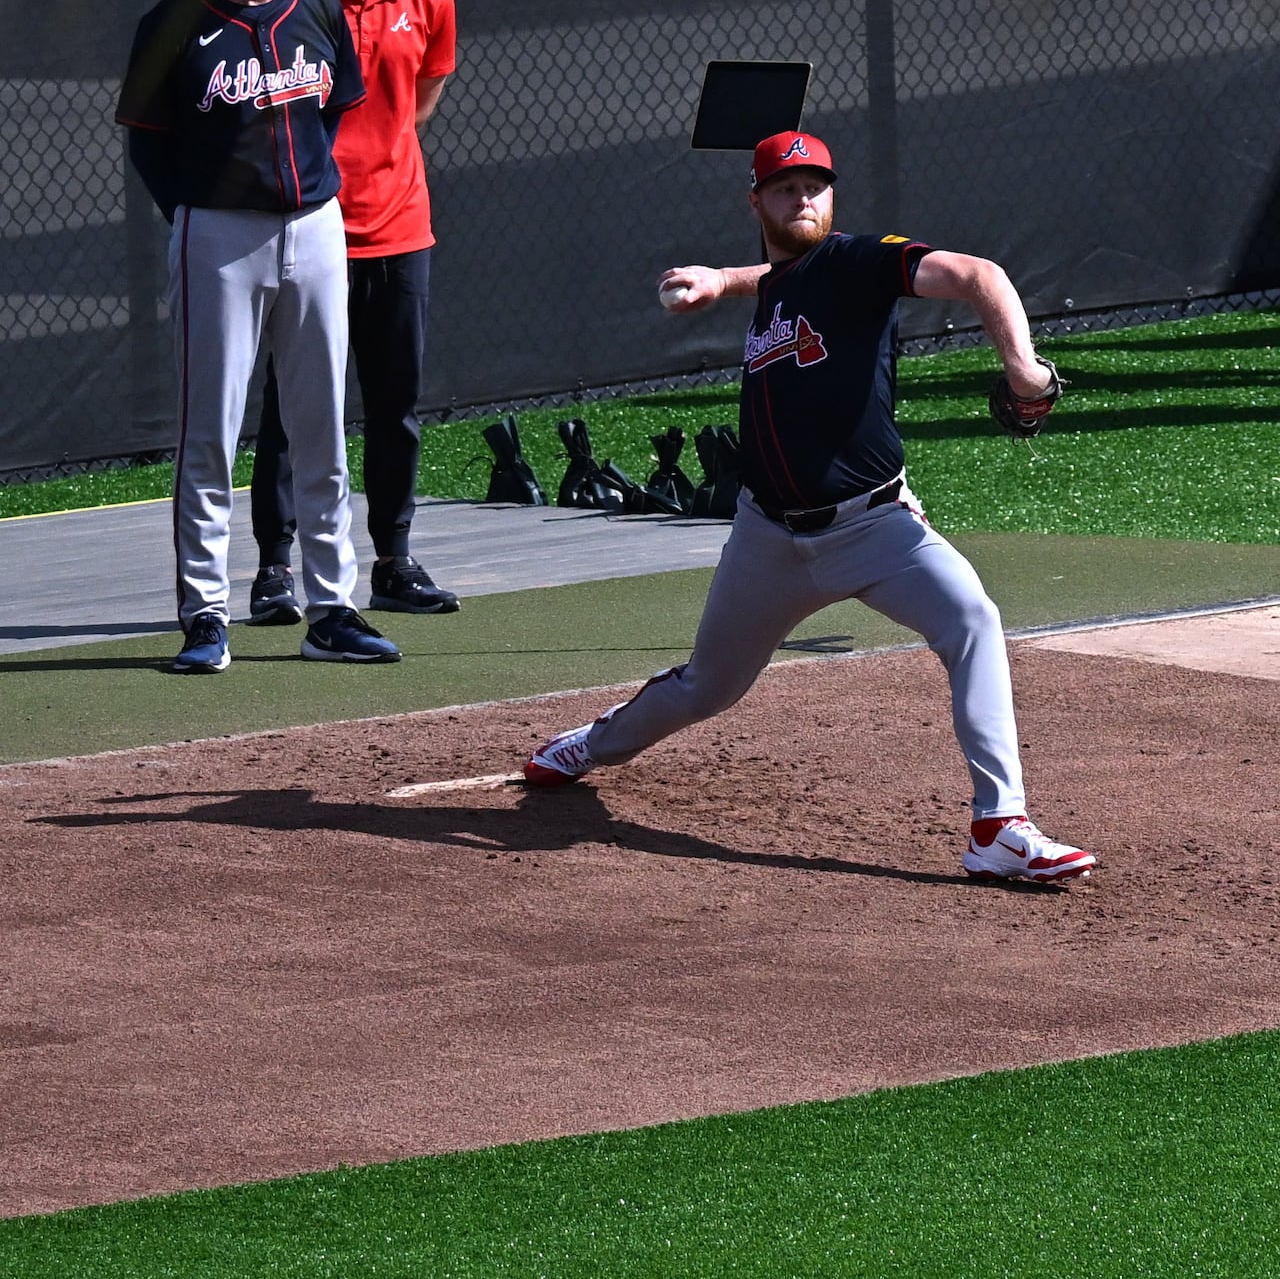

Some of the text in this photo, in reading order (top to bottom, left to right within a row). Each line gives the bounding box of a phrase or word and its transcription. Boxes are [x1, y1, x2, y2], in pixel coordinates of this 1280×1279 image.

[390, 11, 412, 32] A
[196, 44, 319, 113] Atlanta
[781, 136, 810, 160] A
